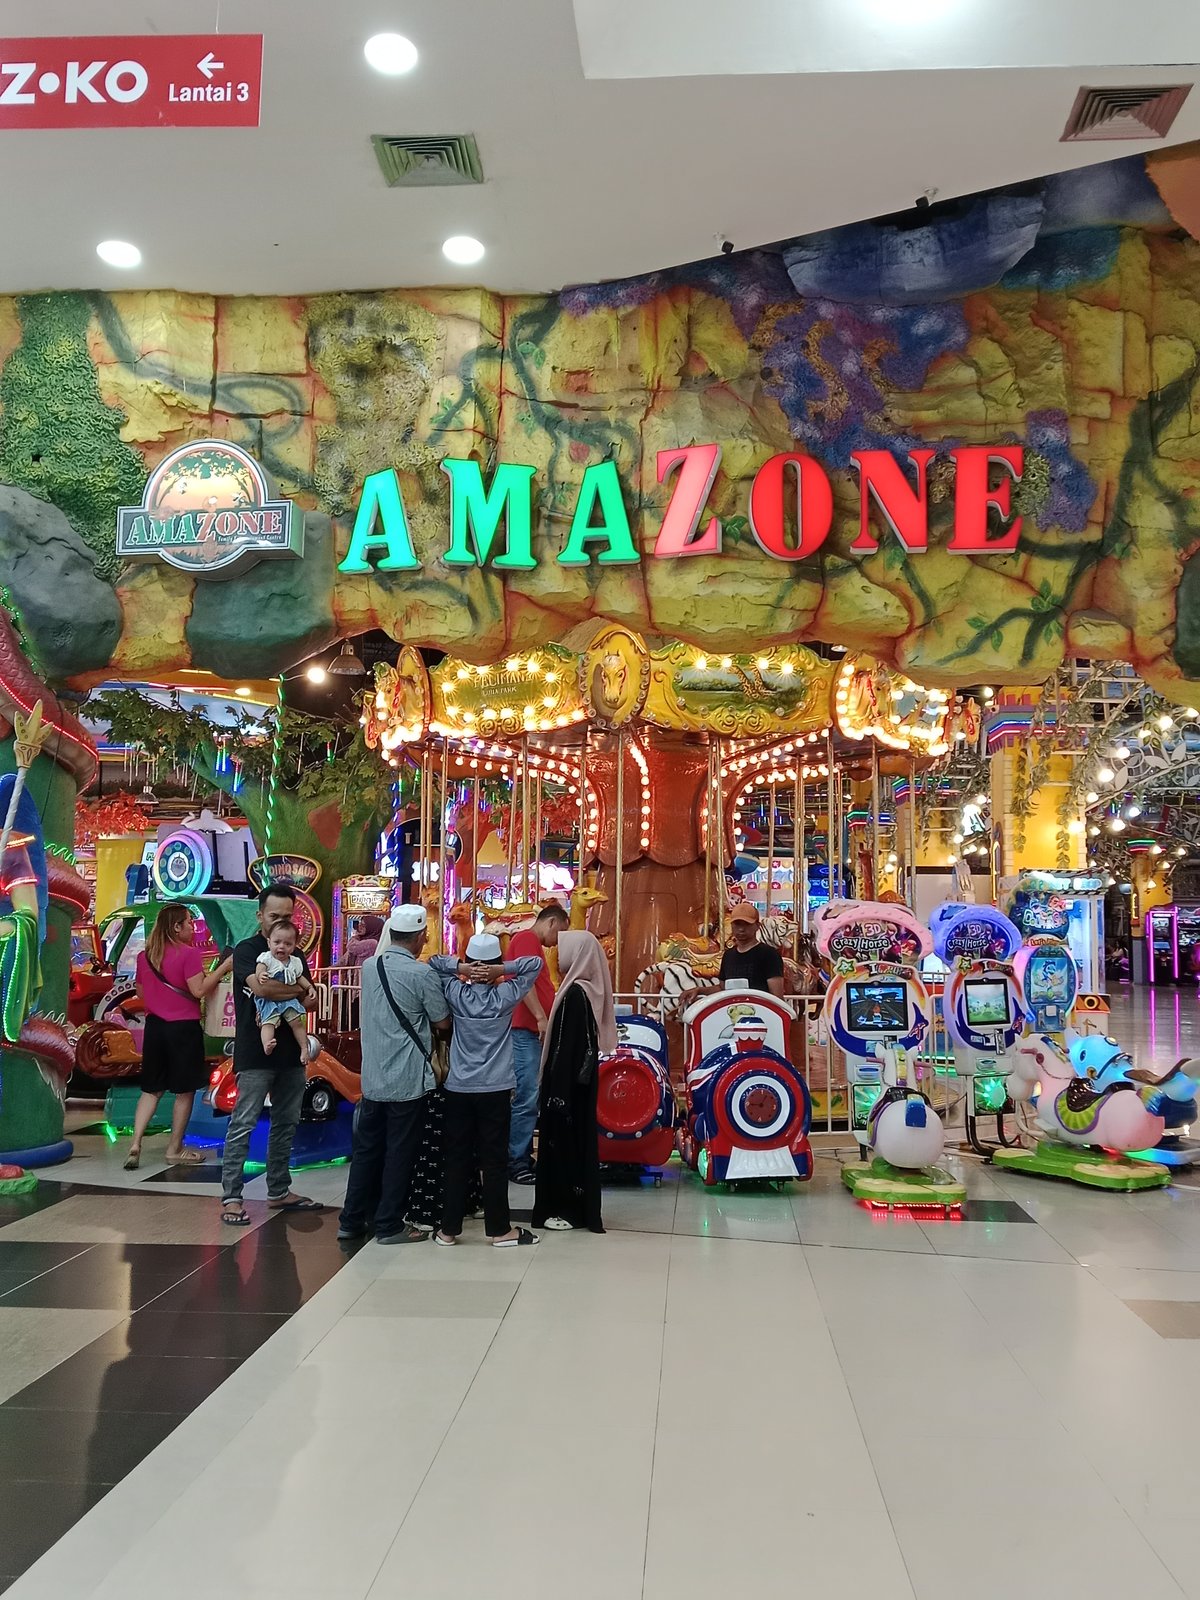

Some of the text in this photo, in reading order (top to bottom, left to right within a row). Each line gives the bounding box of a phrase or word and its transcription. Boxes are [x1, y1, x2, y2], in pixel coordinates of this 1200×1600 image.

[169, 82, 249, 102] Lantai 3
[338, 443, 1024, 575] AMAZONE
[126, 510, 282, 545] AMAZONE
[269, 863, 316, 878] DINOSAUR
[865, 923, 881, 937] 3D
[970, 924, 982, 936] 3D
[833, 937, 888, 949] Crazy Horse
[947, 938, 988, 949] Crazy Horse
